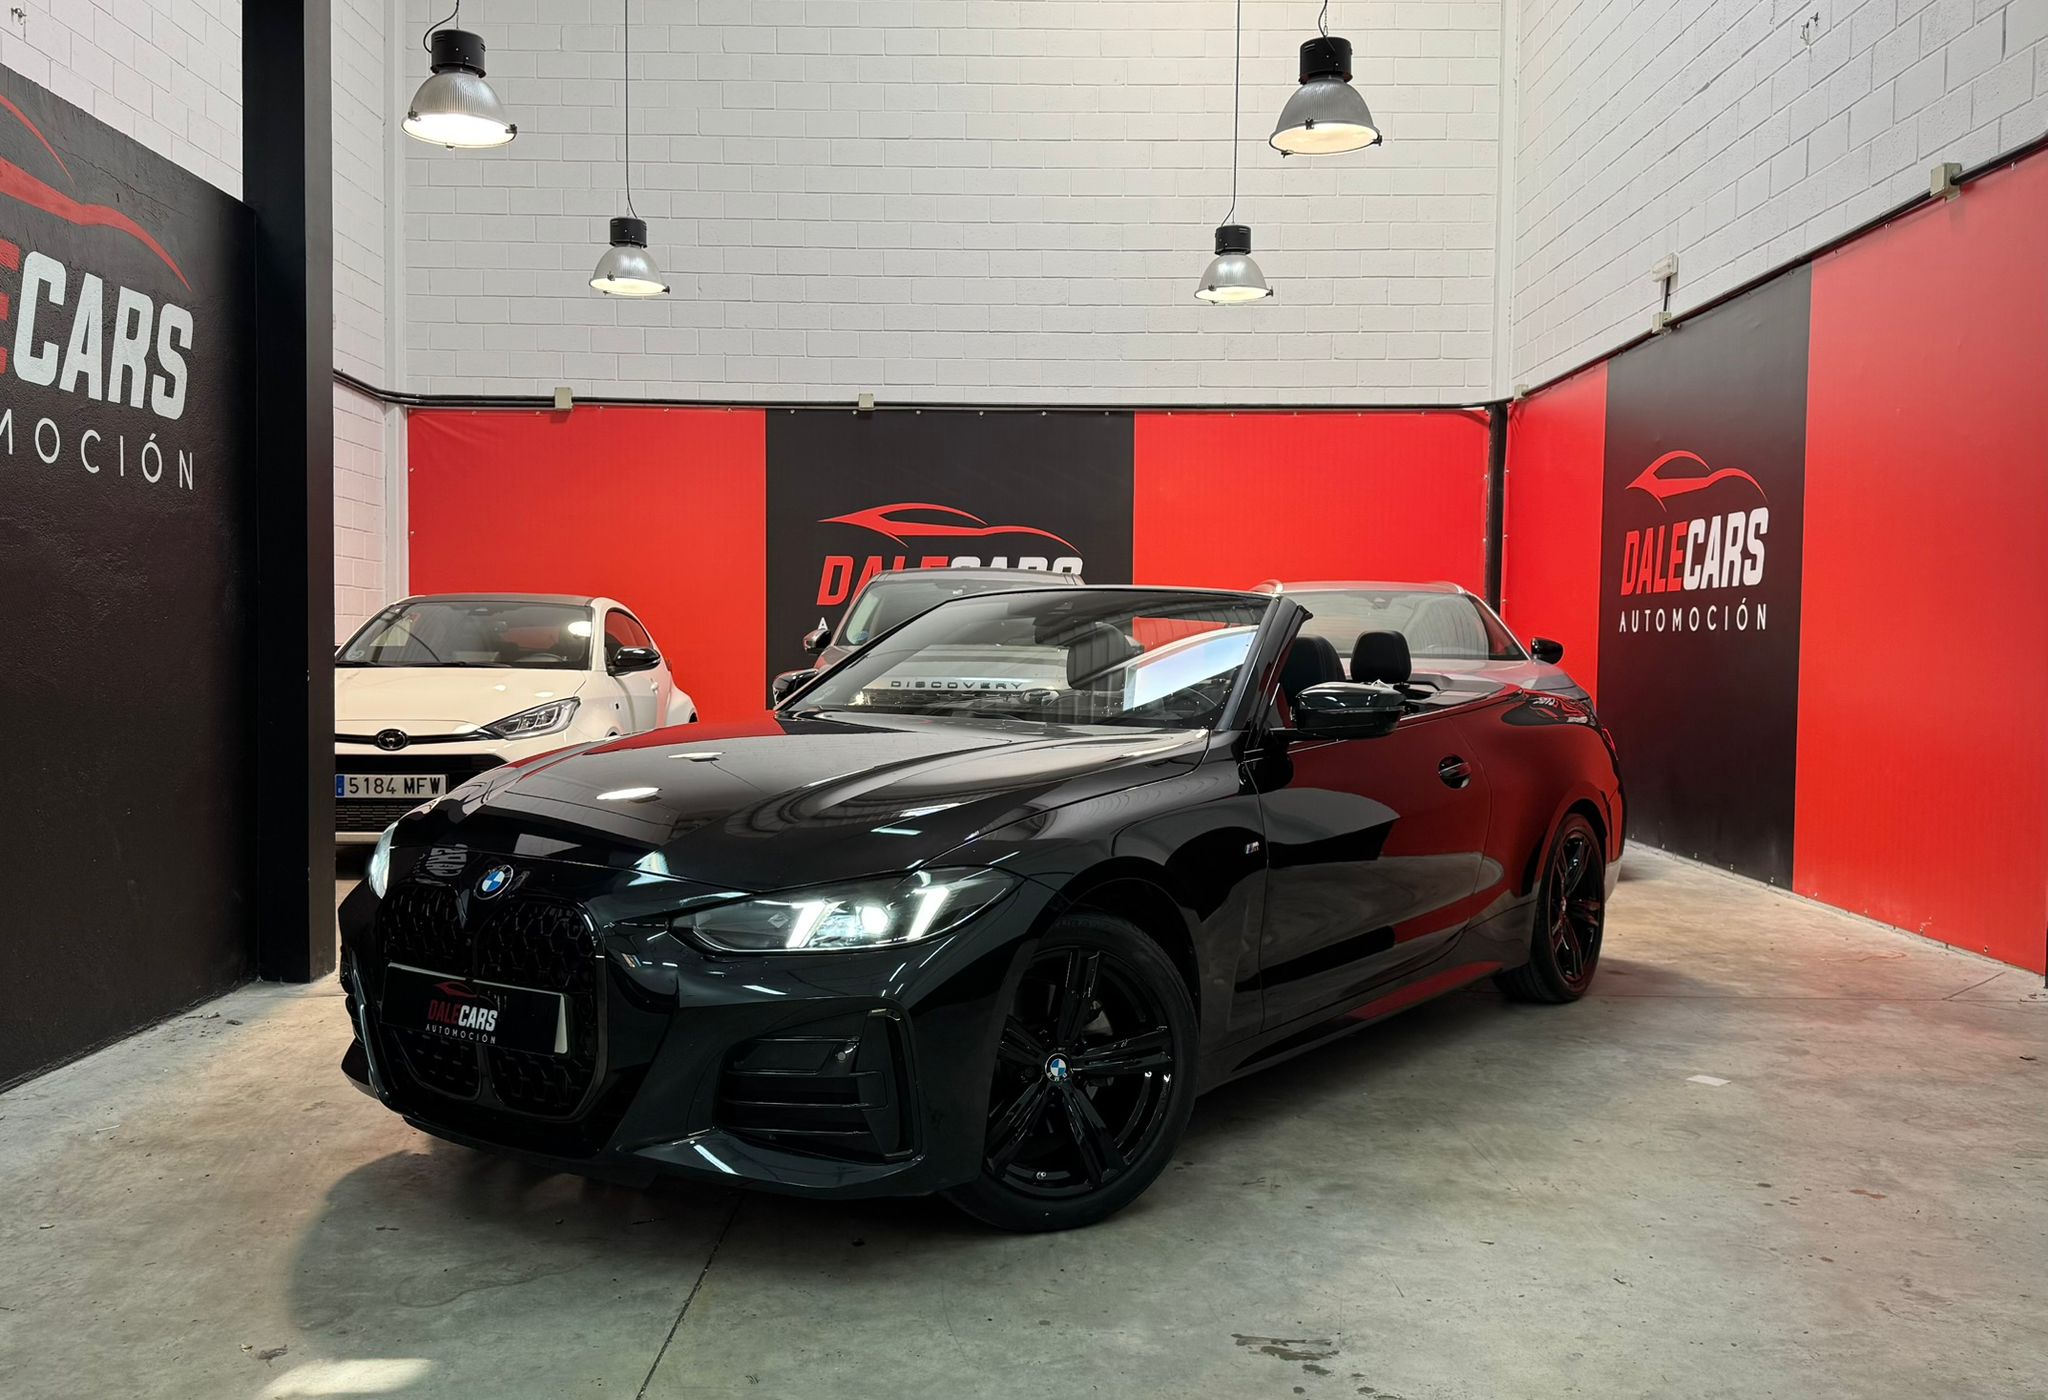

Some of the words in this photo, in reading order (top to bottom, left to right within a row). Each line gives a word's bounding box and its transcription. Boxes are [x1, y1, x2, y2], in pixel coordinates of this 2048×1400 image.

[1620, 507, 1769, 596] DALECARS
[1619, 597, 1767, 633] AUTOMOCIÓN
[891, 681, 1023, 690] DISCOVERY
[349, 777, 397, 794] 5184
[404, 777, 441, 794] MFW
[427, 999, 498, 1032] DALECARS
[425, 1024, 496, 1044] AUTOMOCIÓN
